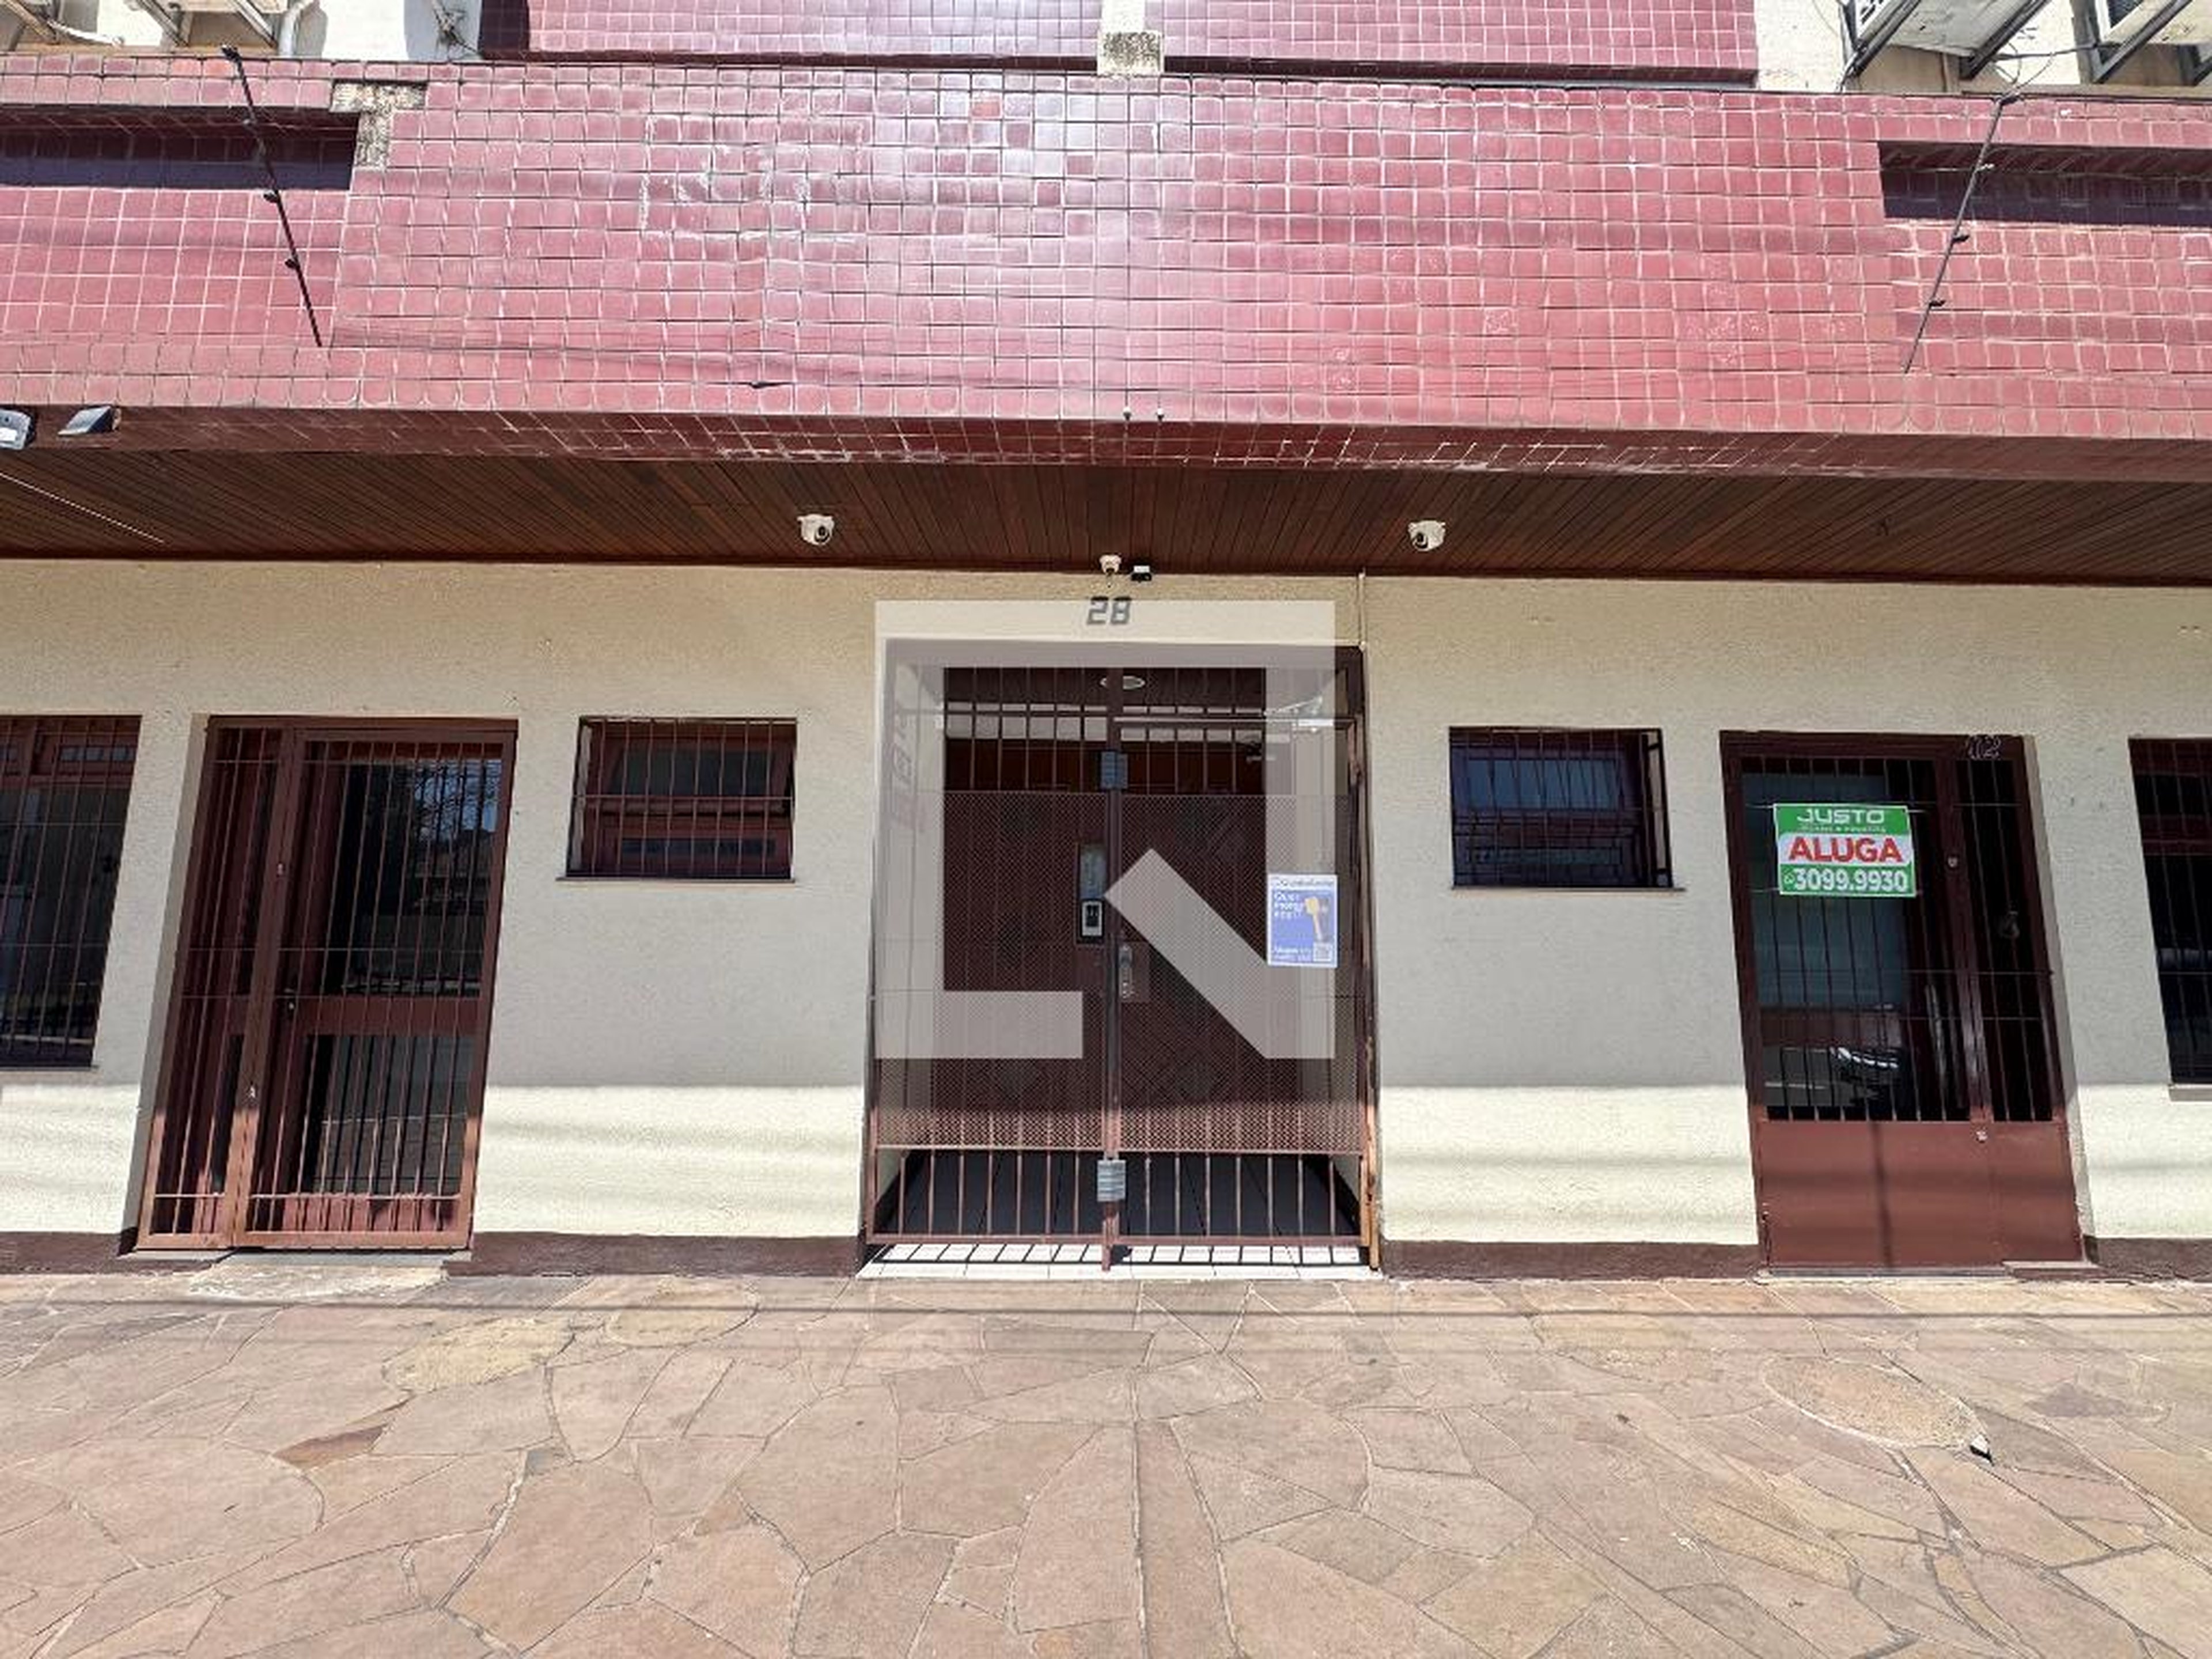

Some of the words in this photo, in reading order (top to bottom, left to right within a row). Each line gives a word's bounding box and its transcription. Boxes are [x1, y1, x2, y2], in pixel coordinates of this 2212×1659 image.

[1087, 597, 1131, 624] 28
[1797, 808, 1884, 824] JUSTO
[1788, 836, 1903, 863] ALUGA
[1793, 868, 1908, 891] 3099.9930
